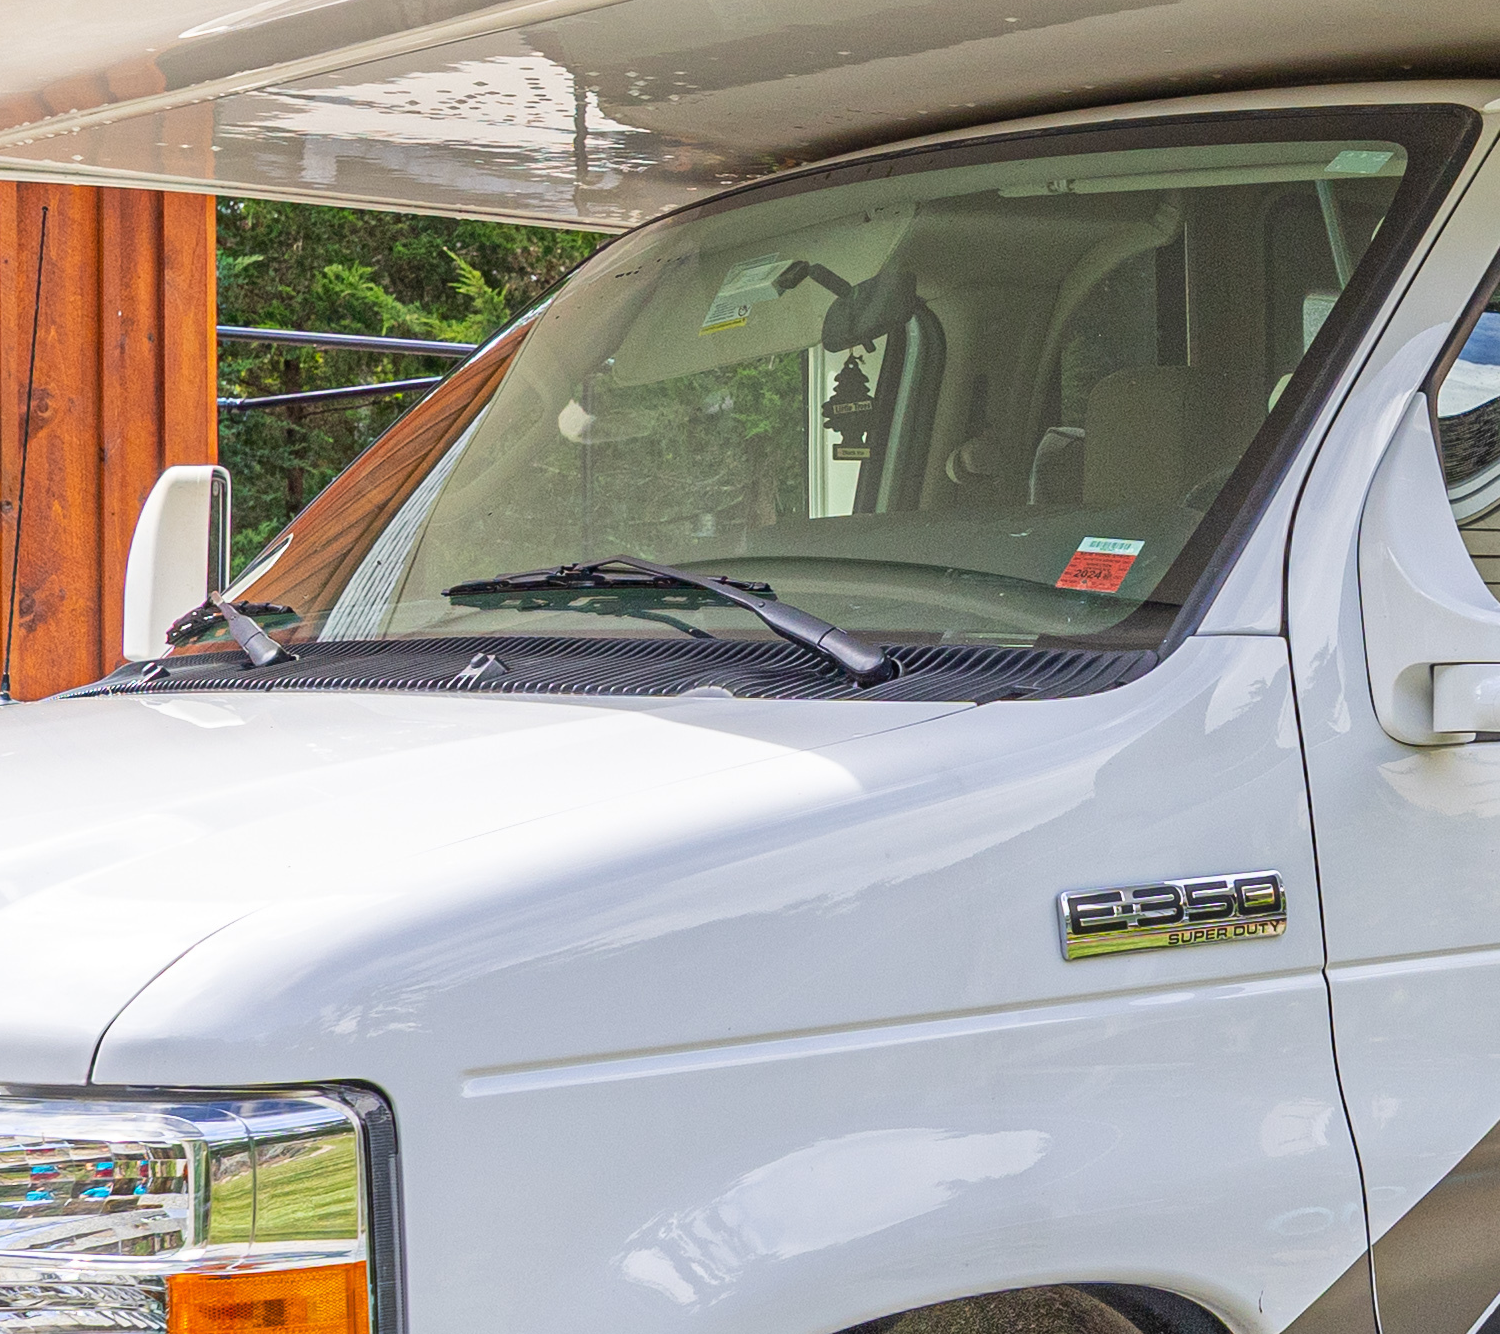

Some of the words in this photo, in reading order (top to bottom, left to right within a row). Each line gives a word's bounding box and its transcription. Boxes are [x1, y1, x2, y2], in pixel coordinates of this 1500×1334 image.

[1073, 569, 1101, 579] 2024
[1167, 927, 1228, 945] SUPER
[1232, 921, 1280, 937] DUTY
